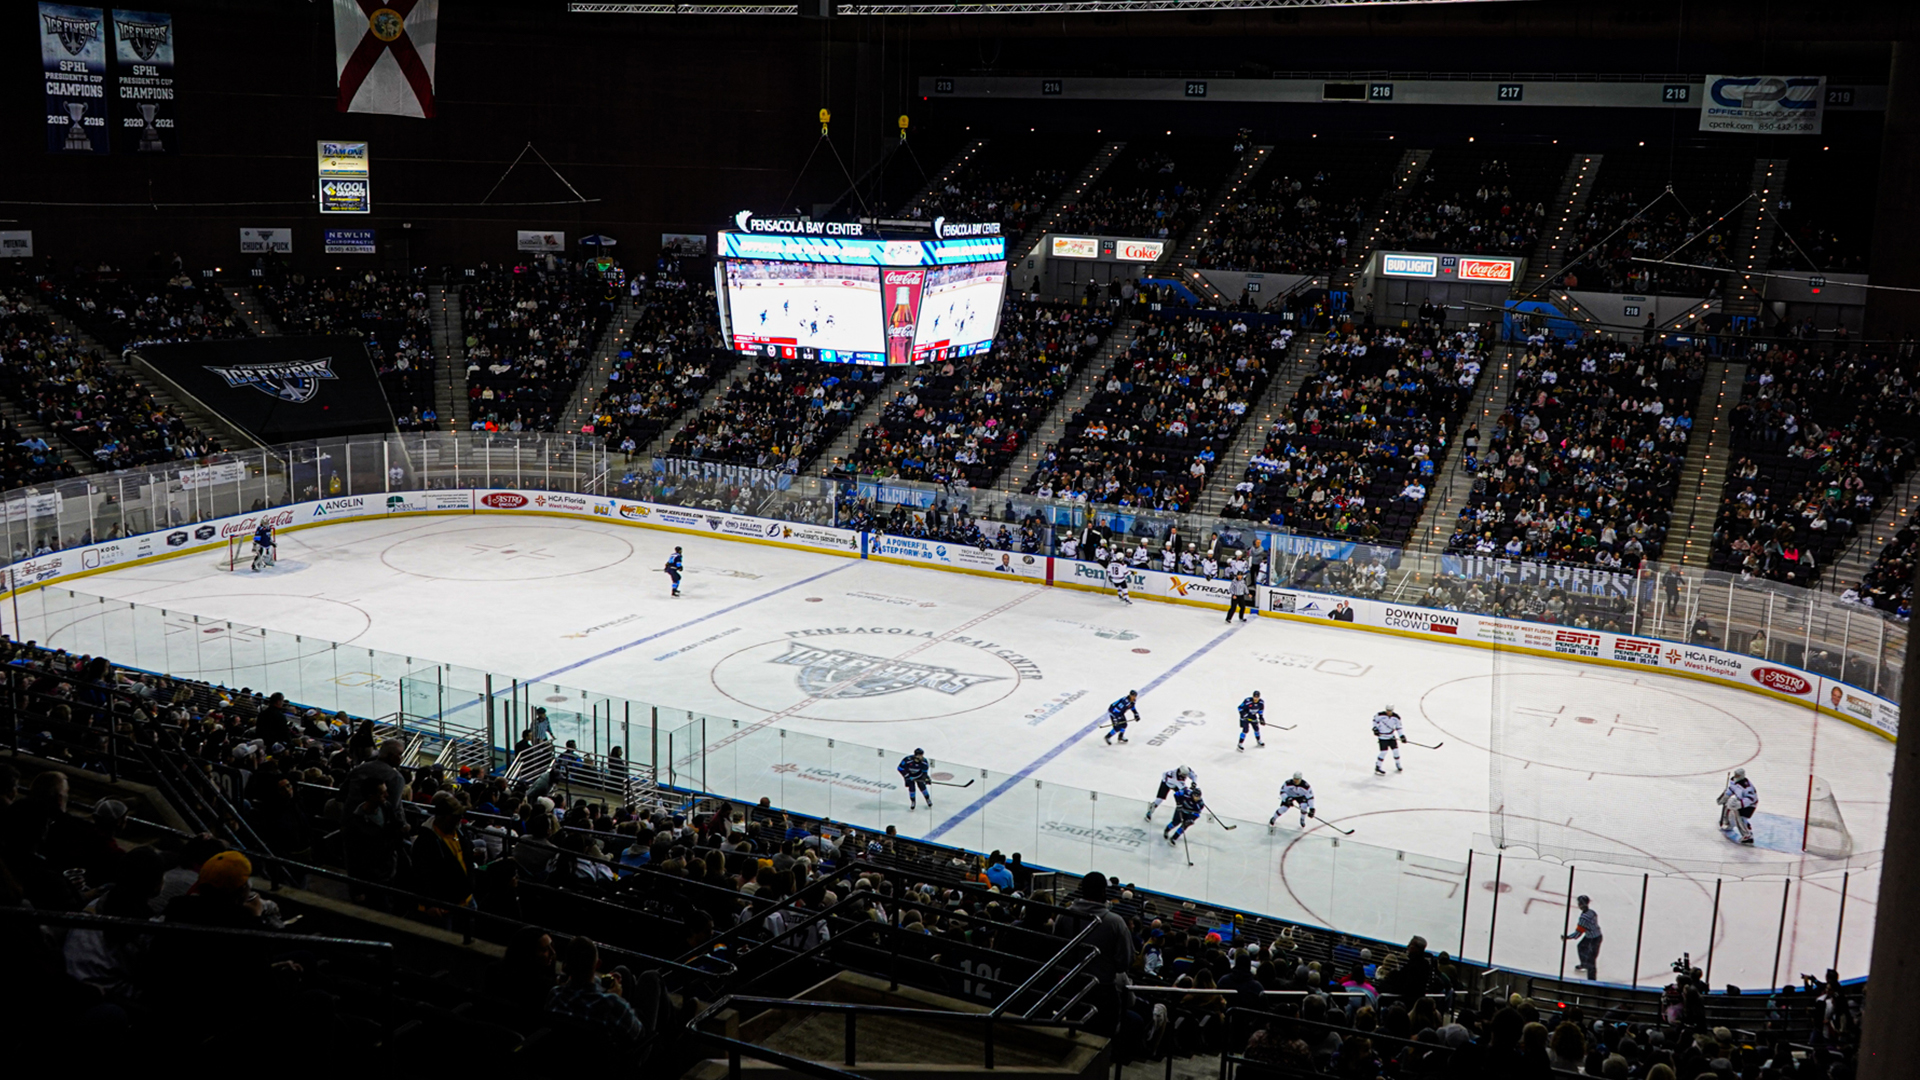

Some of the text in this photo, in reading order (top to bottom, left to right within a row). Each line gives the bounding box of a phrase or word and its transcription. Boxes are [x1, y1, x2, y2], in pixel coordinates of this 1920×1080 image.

[45, 18, 99, 38] ICE FLYERS
[119, 24, 167, 43] ICE FLYERS
[60, 61, 88, 72] SPHL
[133, 65, 159, 76] SPHL
[45, 72, 103, 83] PRESIDENT'S CUP
[119, 77, 160, 86] PRESIDENT'S
[46, 82, 103, 97] CHAMPIONS
[937, 82, 952, 91] 213
[1045, 83, 1059, 91] 214
[1188, 84, 1204, 94] 215
[1372, 86, 1390, 97] 216
[1500, 87, 1520, 97] 217
[120, 87, 173, 99] CHAMPIONS
[1666, 88, 1686, 99] 218
[1711, 79, 1819, 108] CPC
[1829, 92, 1851, 102] 219
[47, 116, 104, 126] 2015 2016
[124, 119, 174, 128] 2020 2021
[1709, 121, 1814, 132] cpctek.com 850-432-1580
[336, 182, 363, 192] KOOL
[751, 219, 863, 235] PENSACOLA BAY CENTER
[943, 222, 1001, 236] PENSACOLA BAY CENTER
[242, 242, 264, 250] CHUCK
[1104, 241, 1114, 249] 215
[1125, 245, 1157, 259] Coke
[1387, 259, 1433, 272] BUD LIGHT
[1443, 258, 1455, 266] 217
[1468, 262, 1510, 278] Coca-Cola
[885, 271, 922, 285] Coca-Cola
[215, 359, 333, 388] ICE FLYERS
[325, 498, 363, 511] ANGLIN
[491, 494, 524, 504] ASTRO
[548, 495, 586, 505] HCA Florida
[221, 517, 258, 539] Coca-Cola
[820, 535, 835, 543] IRISH
[836, 537, 848, 545] PUB
[101, 544, 120, 553] KOOL
[882, 544, 899, 554] STEP
[1112, 566, 1119, 576] 18
[1386, 607, 1459, 625] DOWNTOWN
[1385, 617, 1429, 631] CROWD
[1478, 621, 1513, 630] ORTHOPEDISTS
[1535, 627, 1554, 635] FLORIDA
[1555, 630, 1600, 646] ESPN
[1555, 641, 1598, 651] PENSACOLA
[1614, 638, 1660, 655] ESPN
[785, 625, 936, 640] PENSACOLA
[997, 648, 1044, 681] CENTER
[1614, 649, 1658, 659] PENSACOLA
[1684, 650, 1741, 669] HCA Florida
[1683, 660, 1737, 678] West Hospital
[1765, 671, 1804, 691] ASTRO
[797, 772, 830, 787] West
[805, 767, 898, 791] HCA Florida
[1038, 820, 1144, 849] Southern
